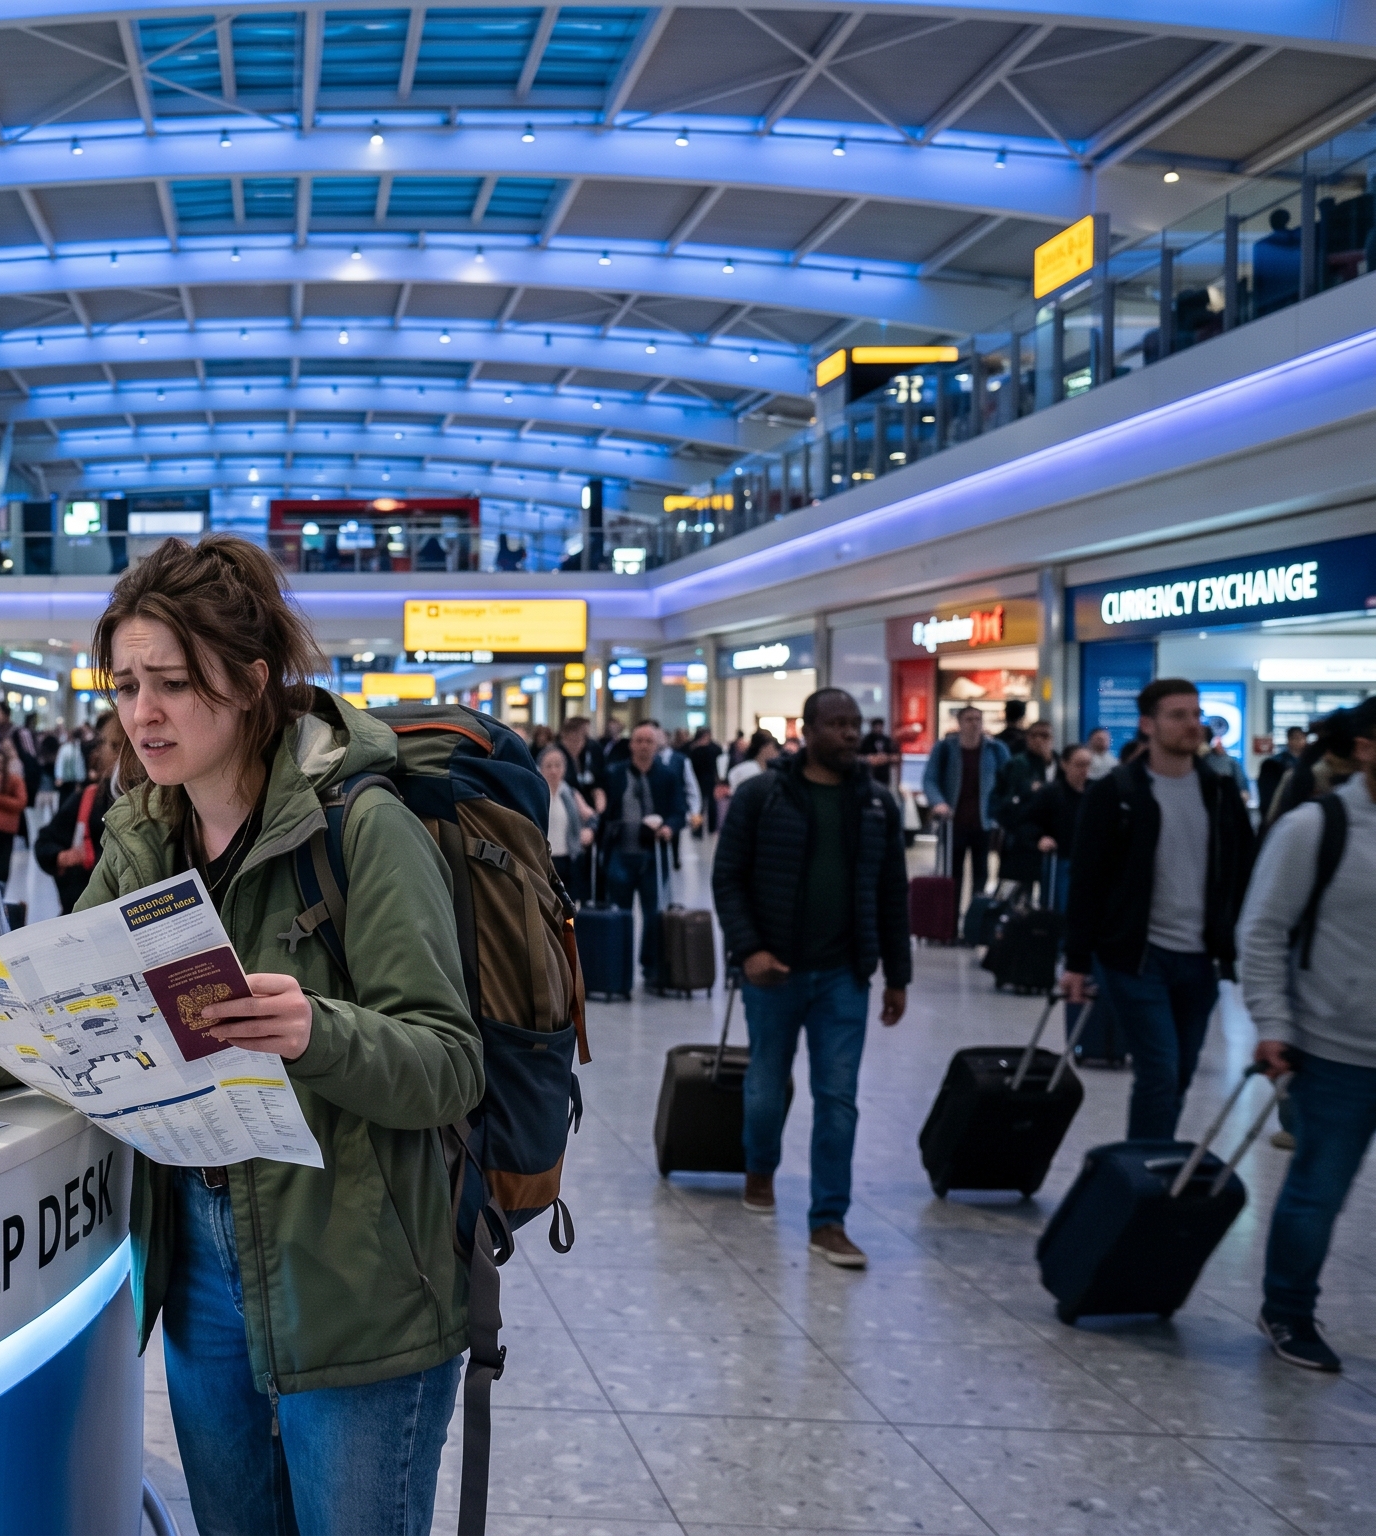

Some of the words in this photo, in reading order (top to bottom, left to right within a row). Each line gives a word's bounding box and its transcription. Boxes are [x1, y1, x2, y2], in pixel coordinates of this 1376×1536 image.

[1100, 580, 1198, 625] CURRENCY
[1197, 561, 1319, 613] EXCHANGE
[38, 1150, 114, 1270] DESK
